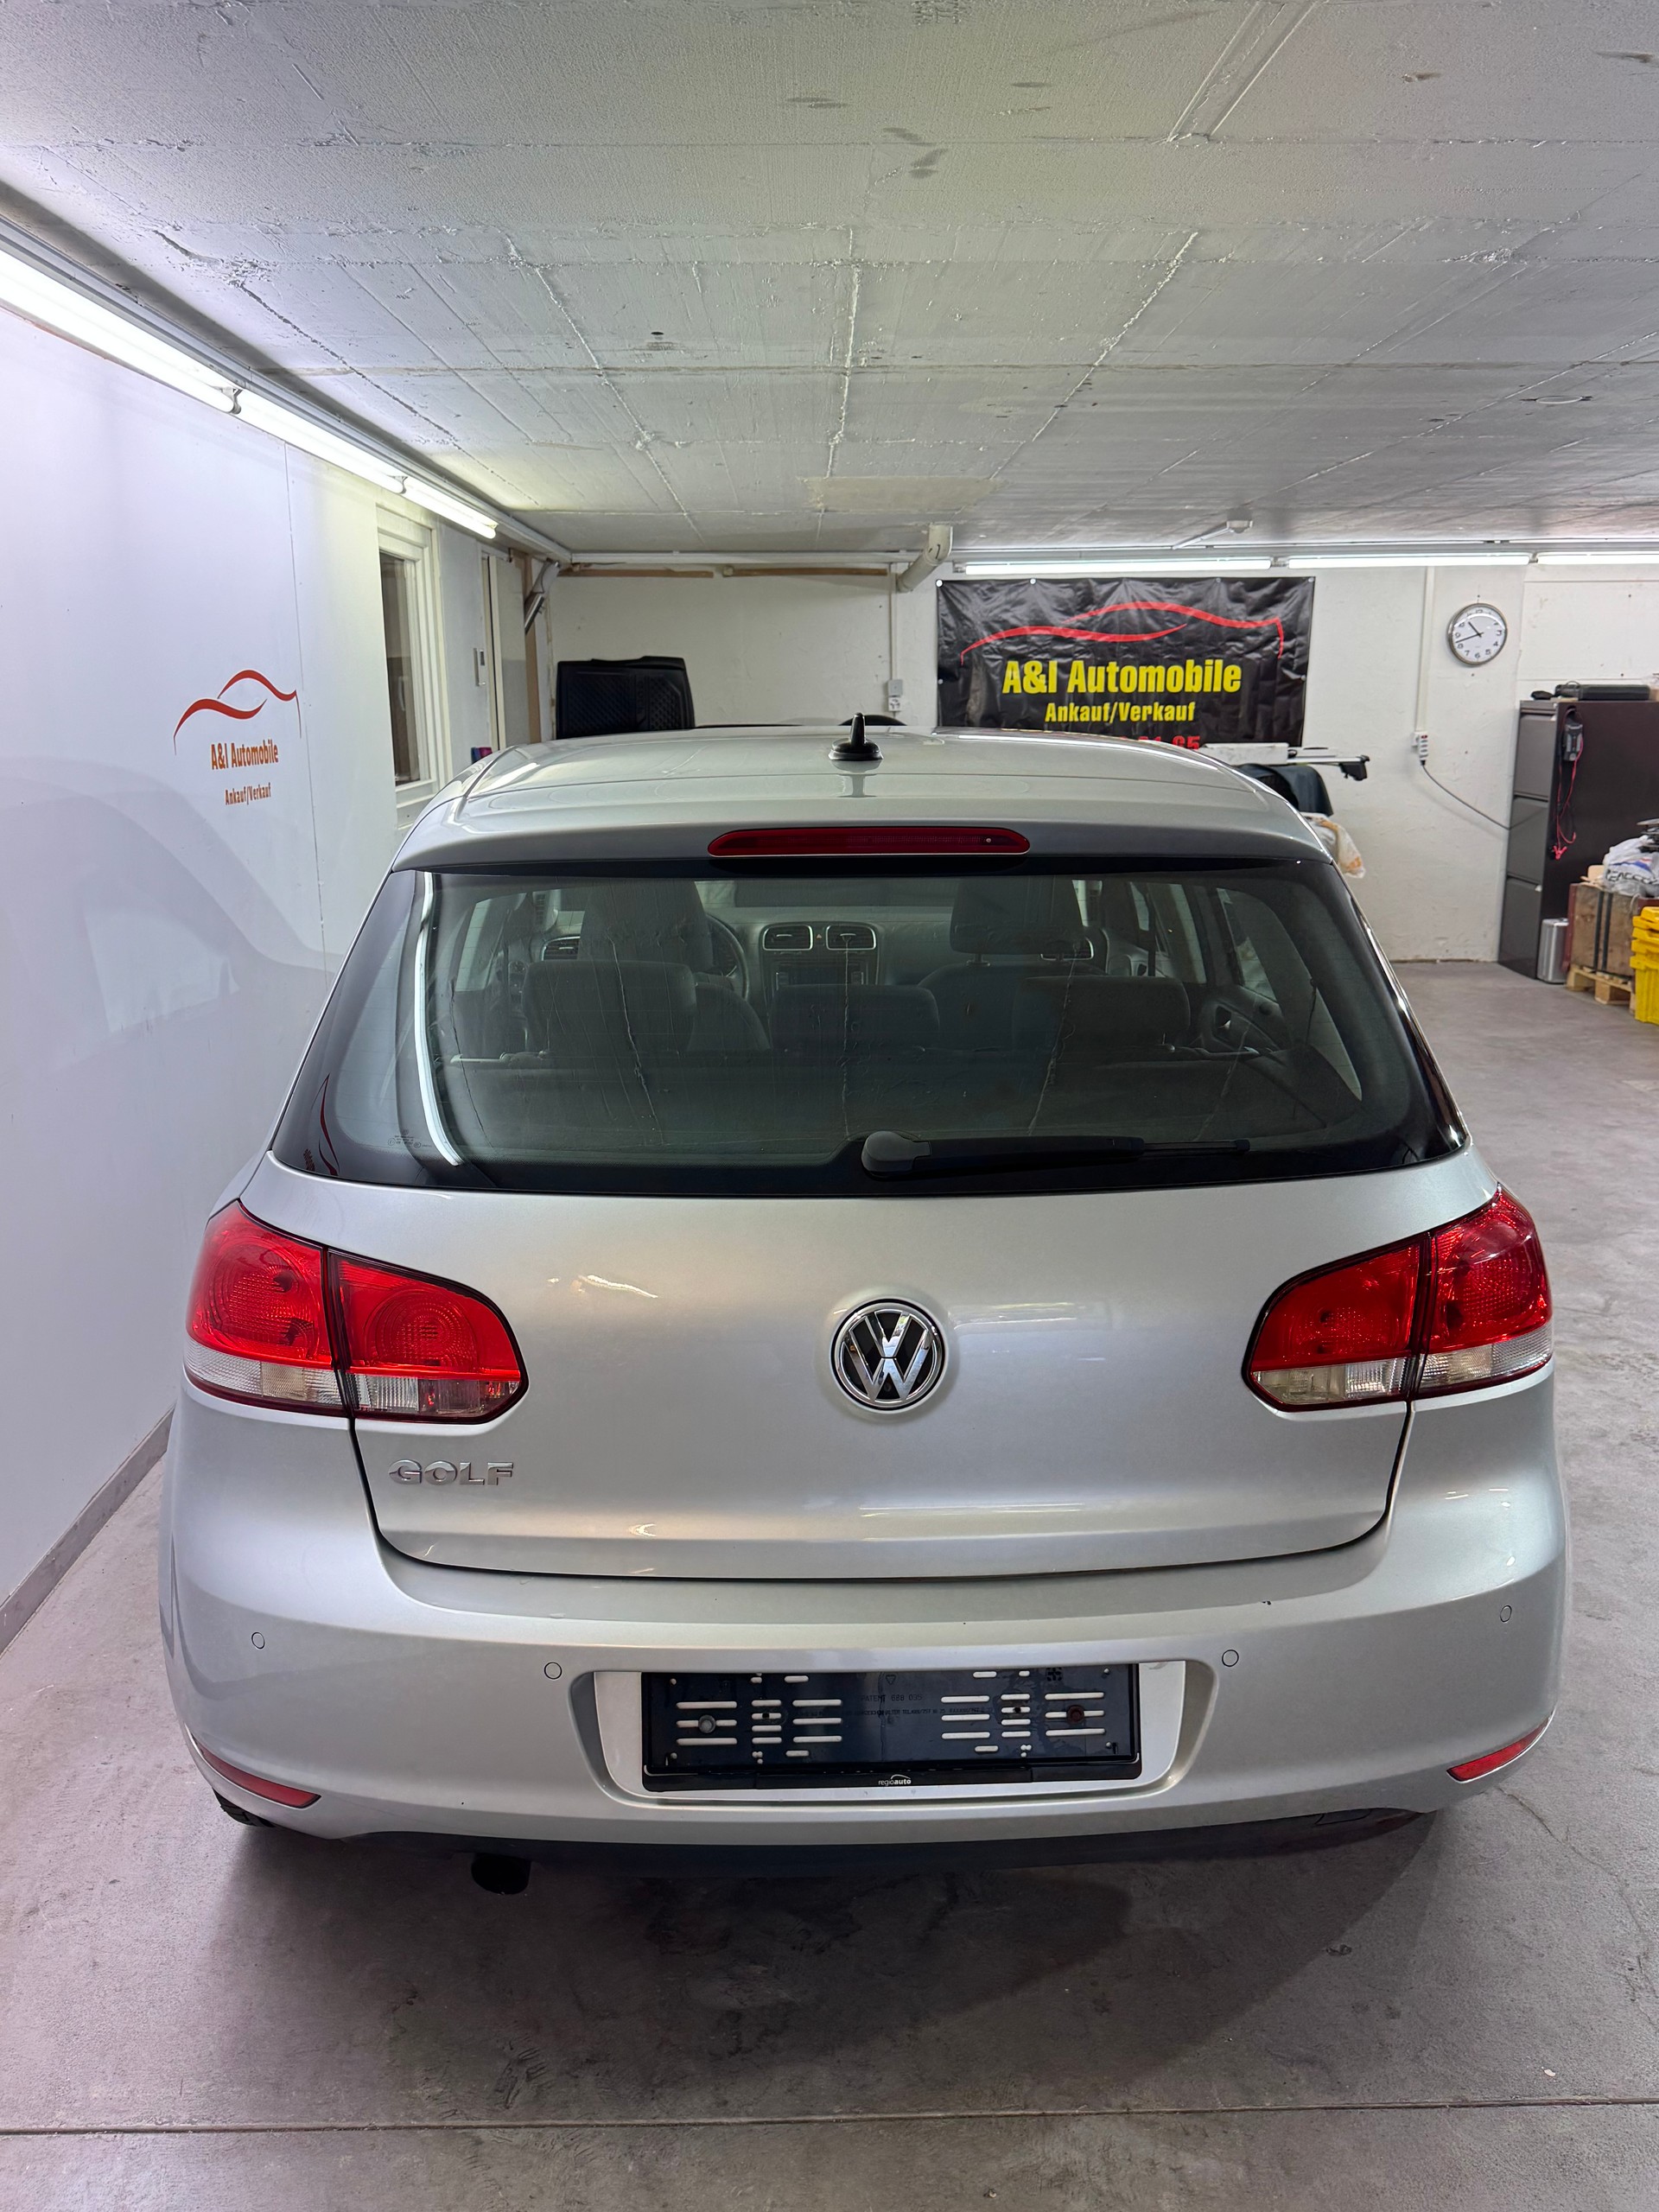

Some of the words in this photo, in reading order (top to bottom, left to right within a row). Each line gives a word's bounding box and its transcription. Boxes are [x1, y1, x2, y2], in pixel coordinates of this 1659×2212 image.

[1002, 660, 1057, 693] A&I
[1067, 659, 1243, 693] Automobile
[1045, 702, 1196, 724] Ankauf/Verkauf
[210, 742, 229, 770] A&I
[231, 739, 279, 767] Automobile
[225, 782, 271, 805] Ankauf/Verkauf
[840, 1307, 939, 1404] VW
[389, 1459, 514, 1485] GOLF
